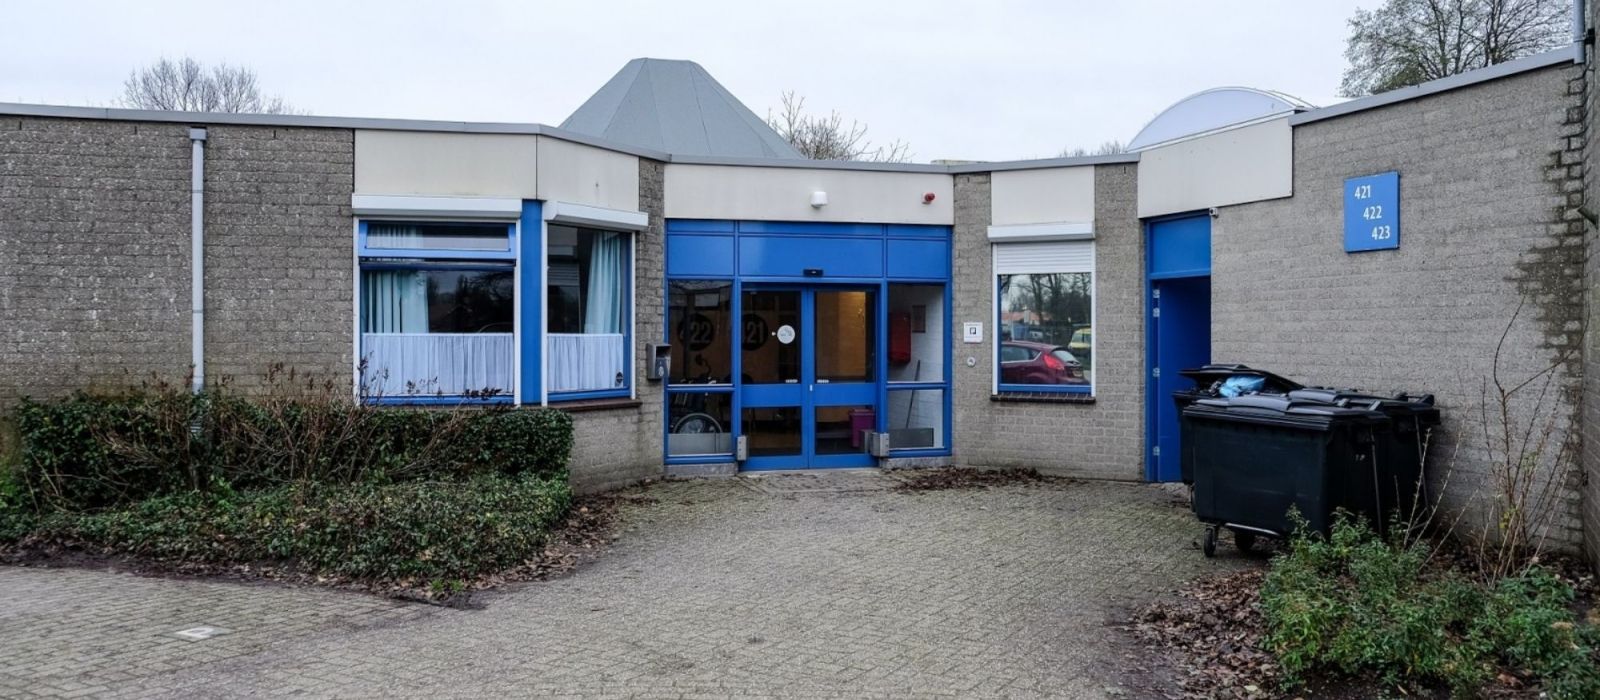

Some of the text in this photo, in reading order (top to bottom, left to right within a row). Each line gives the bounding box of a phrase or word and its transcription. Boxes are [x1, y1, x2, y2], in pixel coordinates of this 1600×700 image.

[1354, 185, 1371, 199] 421
[1363, 206, 1382, 220] 422
[1371, 225, 1391, 240] 423
[743, 320, 764, 344] 21
